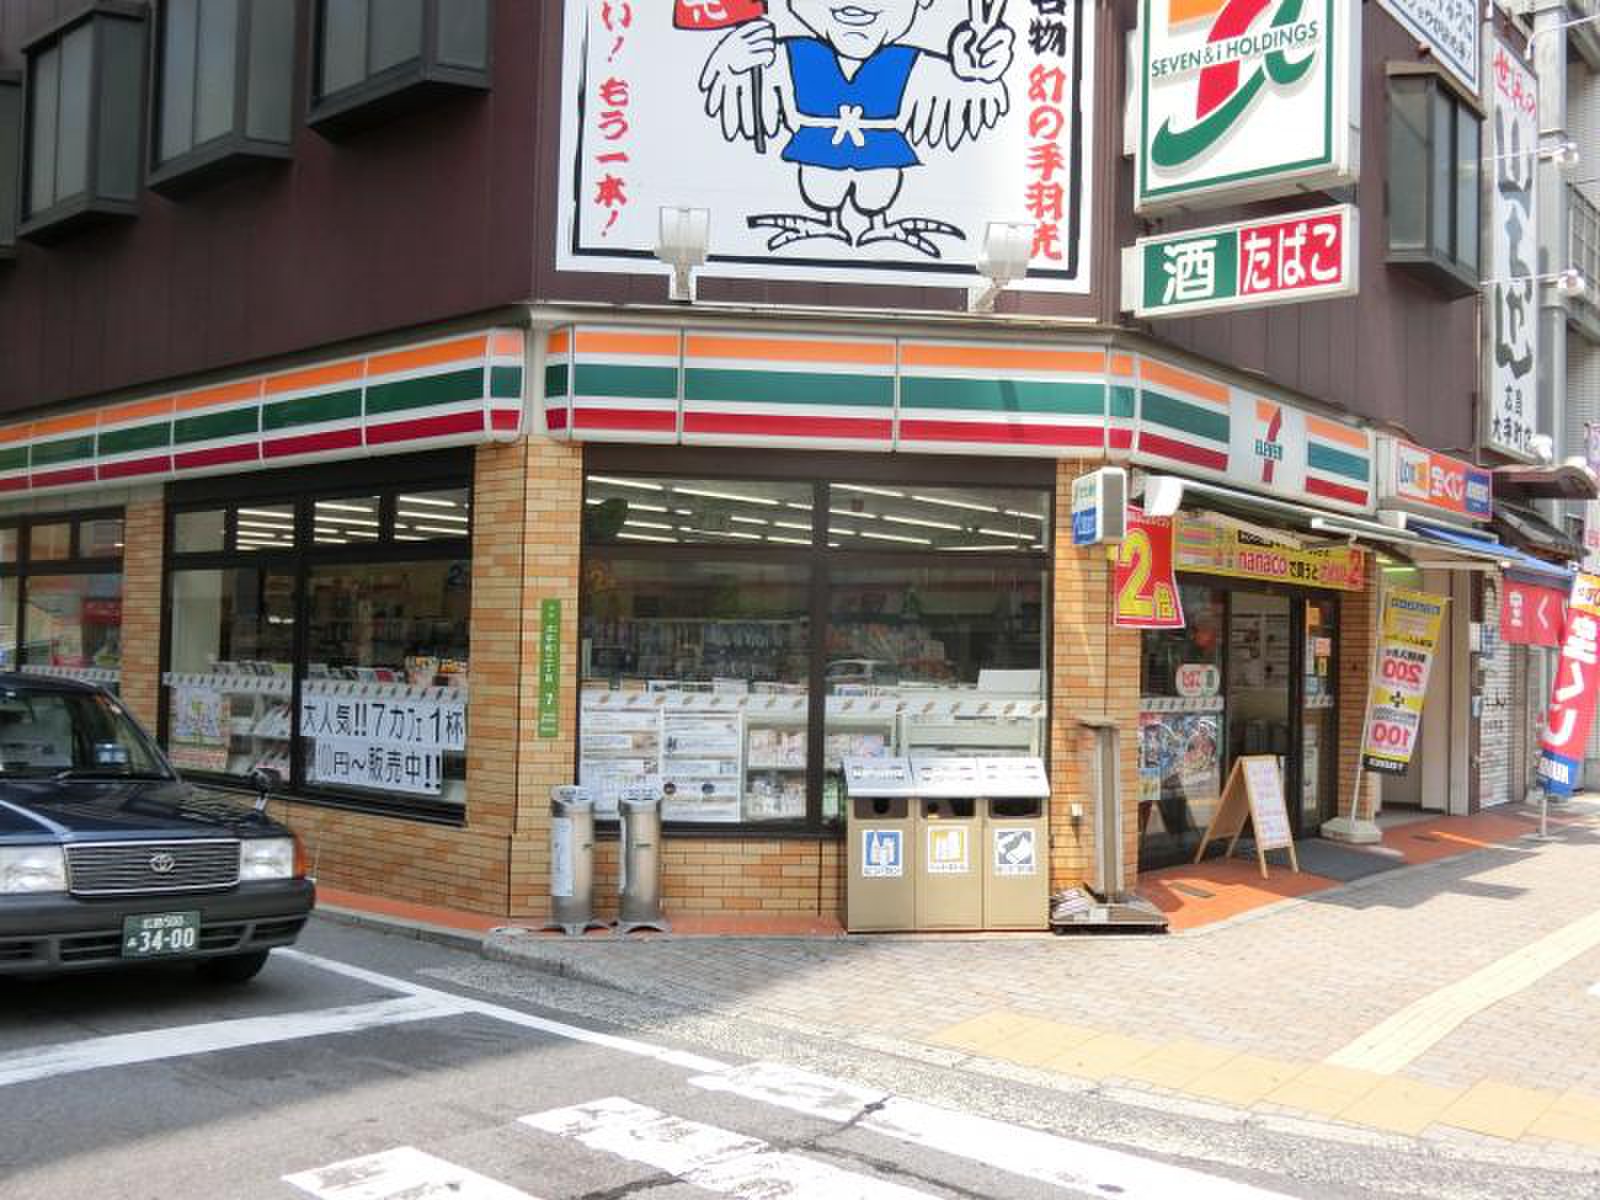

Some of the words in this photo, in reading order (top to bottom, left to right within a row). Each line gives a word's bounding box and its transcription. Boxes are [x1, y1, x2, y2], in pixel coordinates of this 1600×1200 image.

[1226, 21, 1319, 58] HOLDINGS
[594, 77, 630, 238] もう一本!
[1162, 239, 1218, 304] 酒
[1243, 223, 1338, 292] たばこ
[138, 927, 195, 952] 34-00
